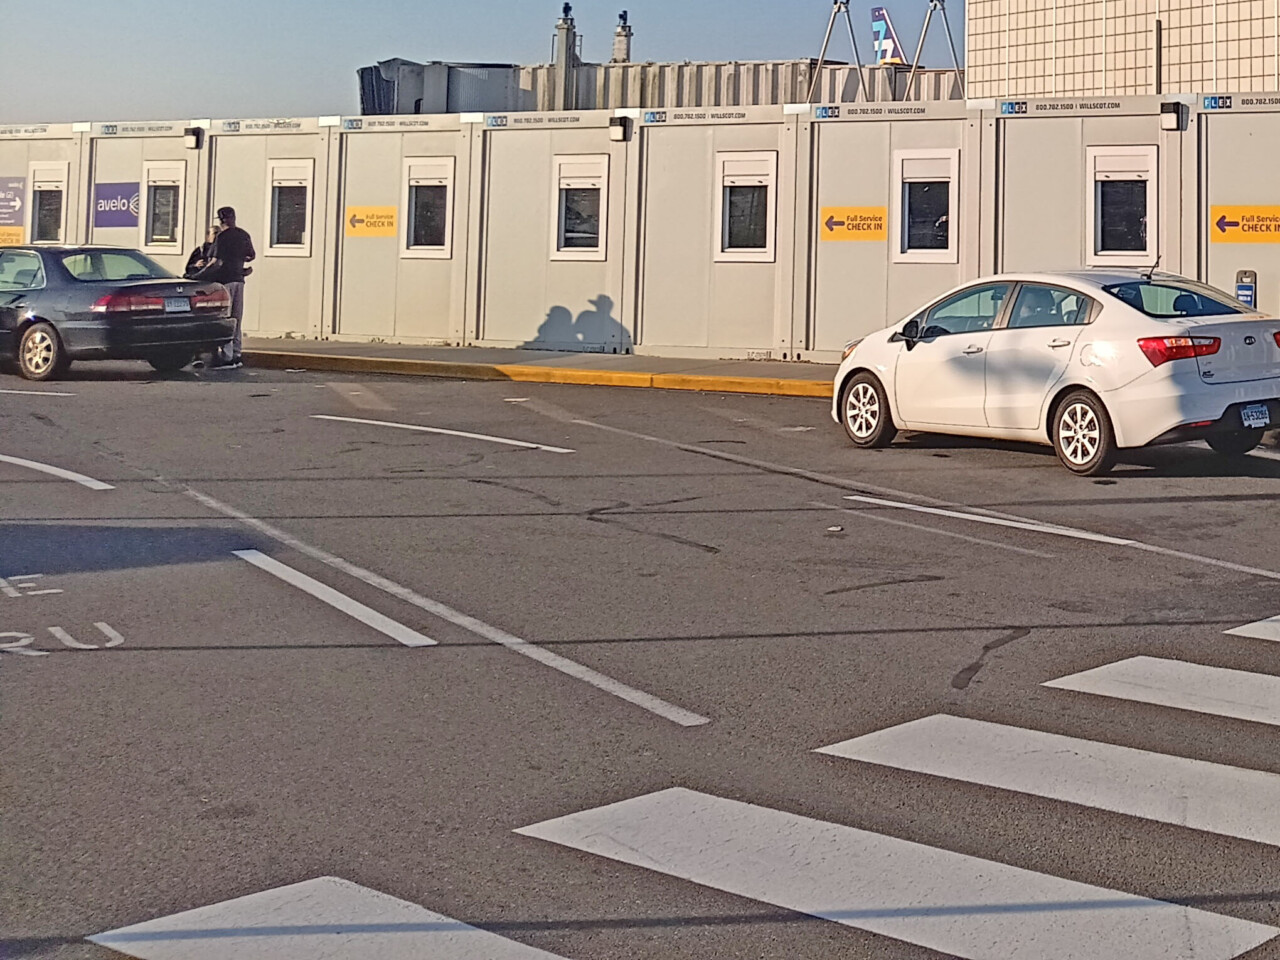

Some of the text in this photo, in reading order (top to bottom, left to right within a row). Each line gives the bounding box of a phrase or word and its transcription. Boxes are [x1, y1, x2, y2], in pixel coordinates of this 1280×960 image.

[1001, 102, 1028, 114] FLEX
[1203, 96, 1232, 109] FLEX
[816, 106, 840, 118] FLEX
[97, 196, 128, 211] avelo
[858, 214, 883, 222] Service
[846, 222, 883, 231] CHECK IN
[1241, 223, 1272, 232] CHECK
